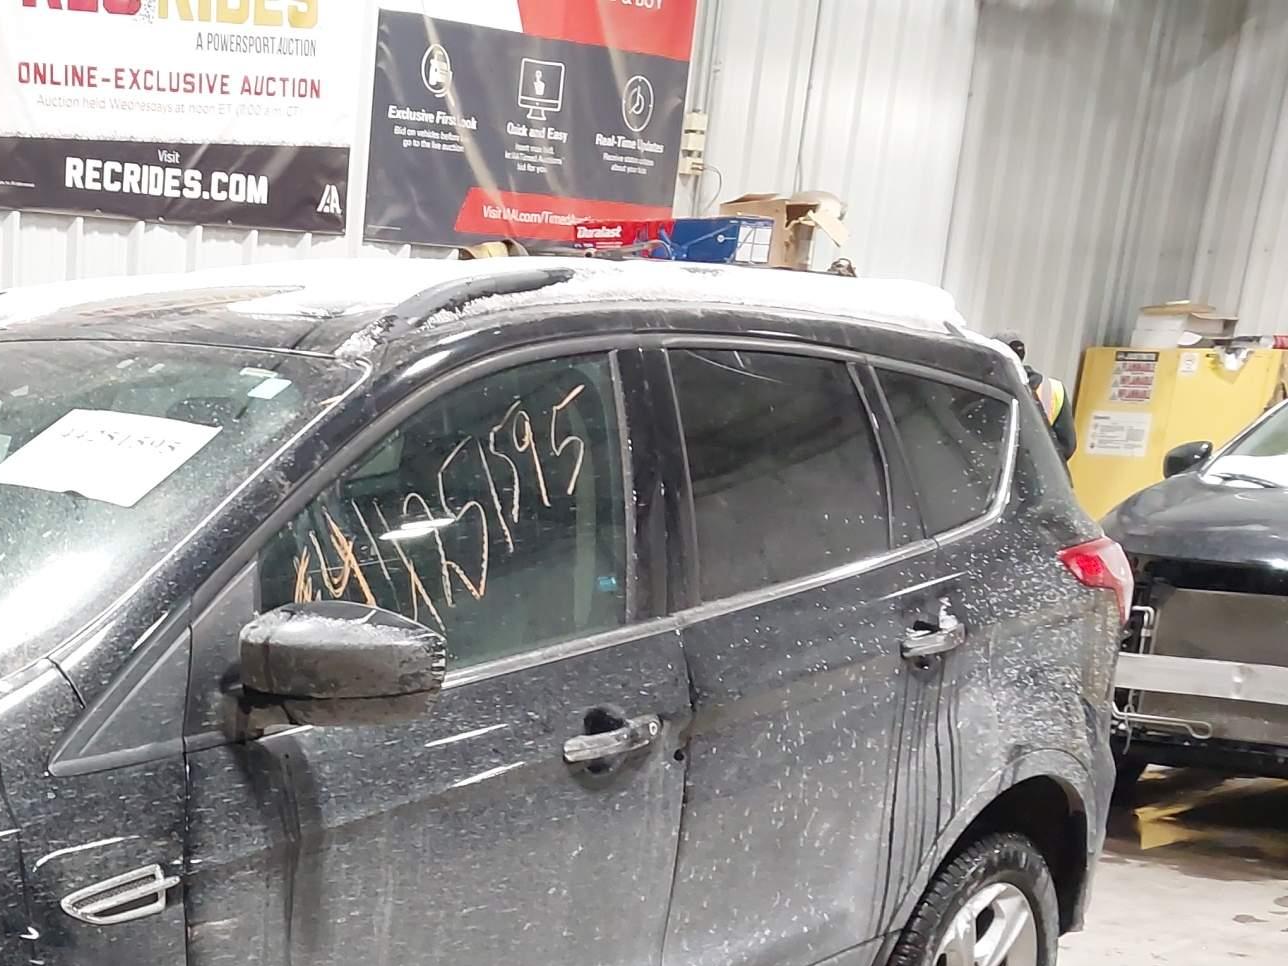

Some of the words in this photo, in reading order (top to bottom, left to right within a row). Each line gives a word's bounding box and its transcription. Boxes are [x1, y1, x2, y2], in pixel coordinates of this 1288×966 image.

[196, 32, 203, 51] A
[207, 33, 276, 54] POWERSPORT
[277, 37, 317, 57] AUCTION
[18, 62, 230, 95] ONLINE-EXCLUSIVE
[240, 74, 320, 99] AUCTION
[388, 105, 435, 124] Exclusive
[507, 122, 528, 137] Quick
[529, 127, 546, 139] and
[547, 127, 569, 144] Easy
[596, 133, 637, 150] Real-Time
[159, 149, 180, 164] Visit
[65, 156, 268, 205] RECRIDES.COM
[483, 205, 502, 219] Visit
